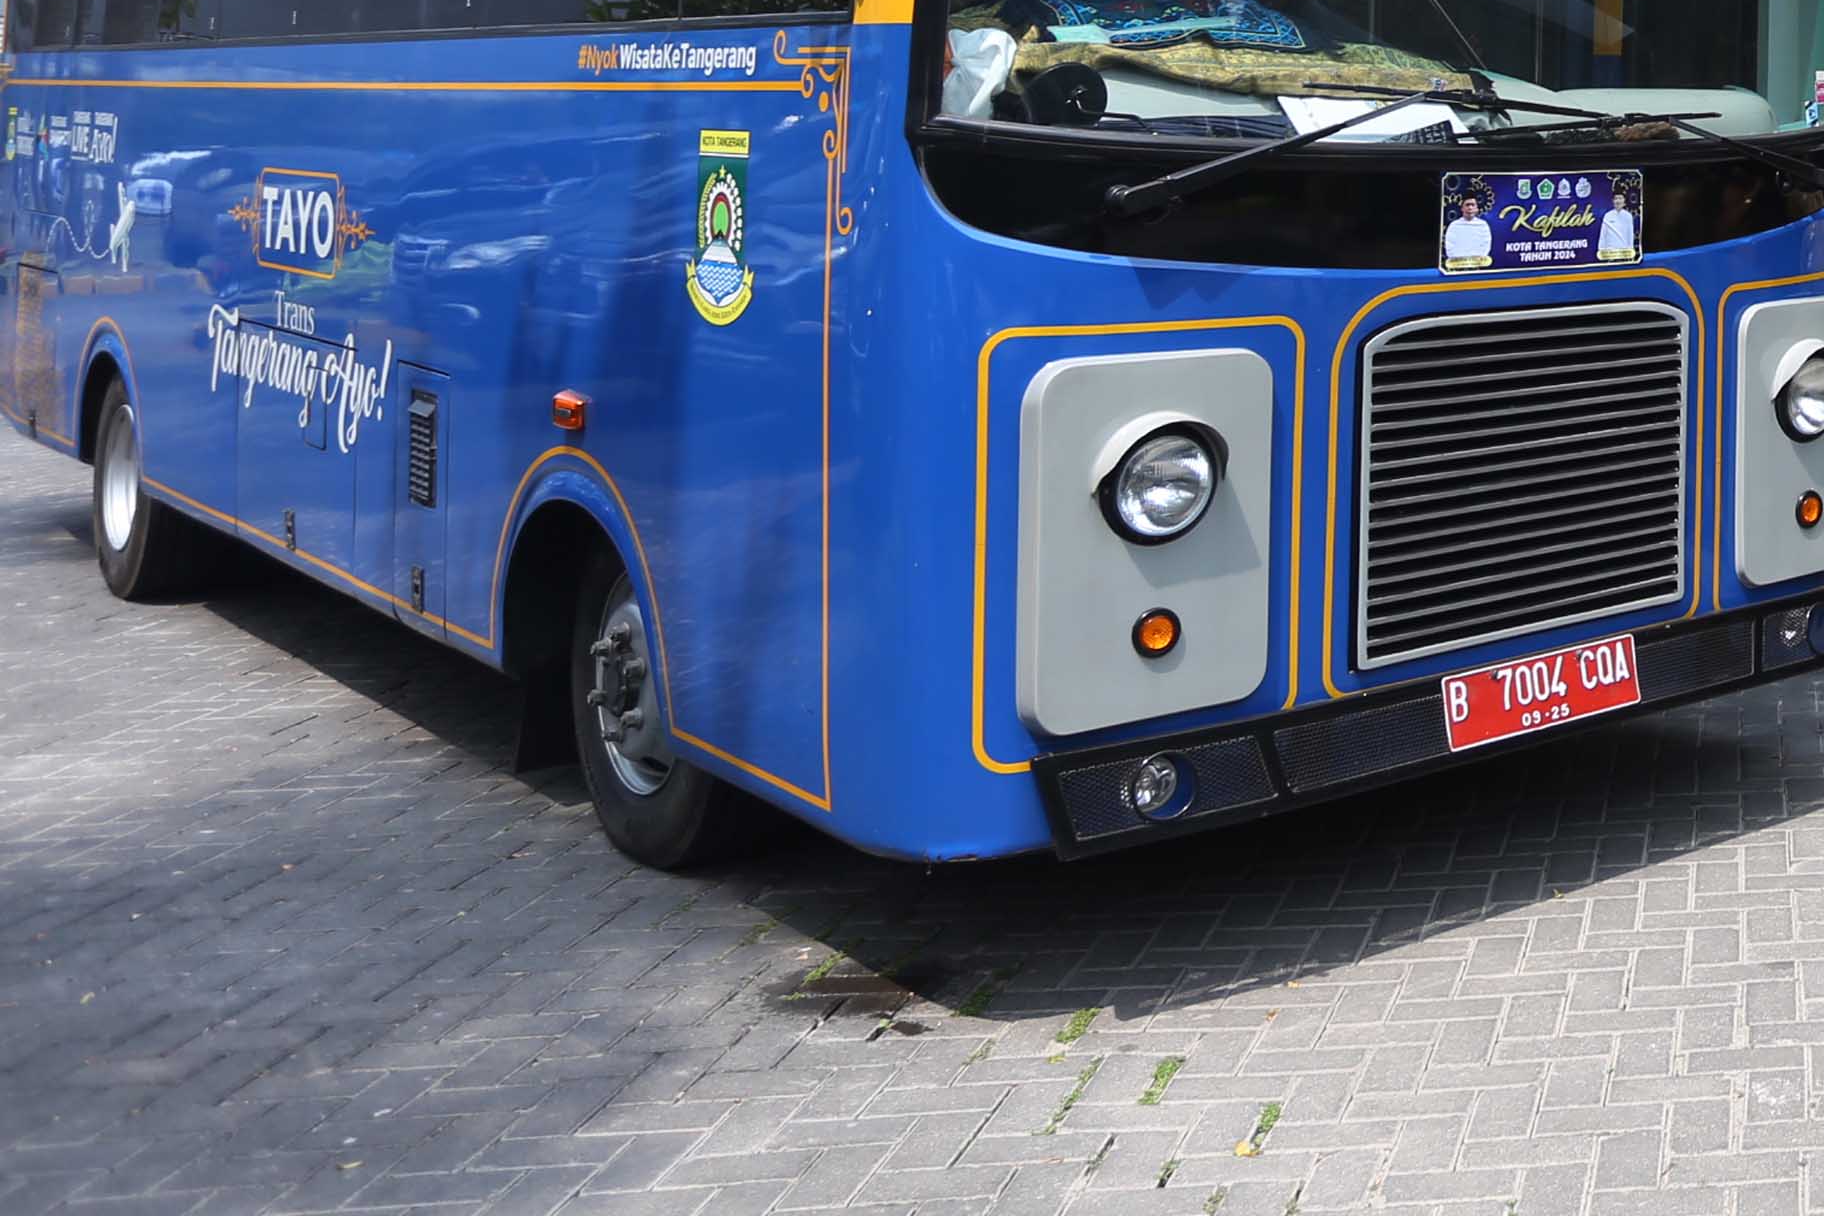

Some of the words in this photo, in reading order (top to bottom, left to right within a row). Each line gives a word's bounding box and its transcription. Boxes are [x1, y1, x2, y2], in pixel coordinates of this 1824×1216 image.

[263, 186, 335, 258] TAYO
[1505, 242, 1533, 253] KOTA
[1534, 239, 1588, 251] TANGERANG
[1520, 252, 1552, 262] TAHUN
[1553, 250, 1577, 261] 2024
[274, 290, 315, 335] Trans
[208, 303, 319, 428] Tangerang
[321, 332, 393, 453] Ayo!
[1449, 681, 1470, 723] B
[1496, 655, 1568, 712] 7004
[1579, 641, 1631, 690] CQA
